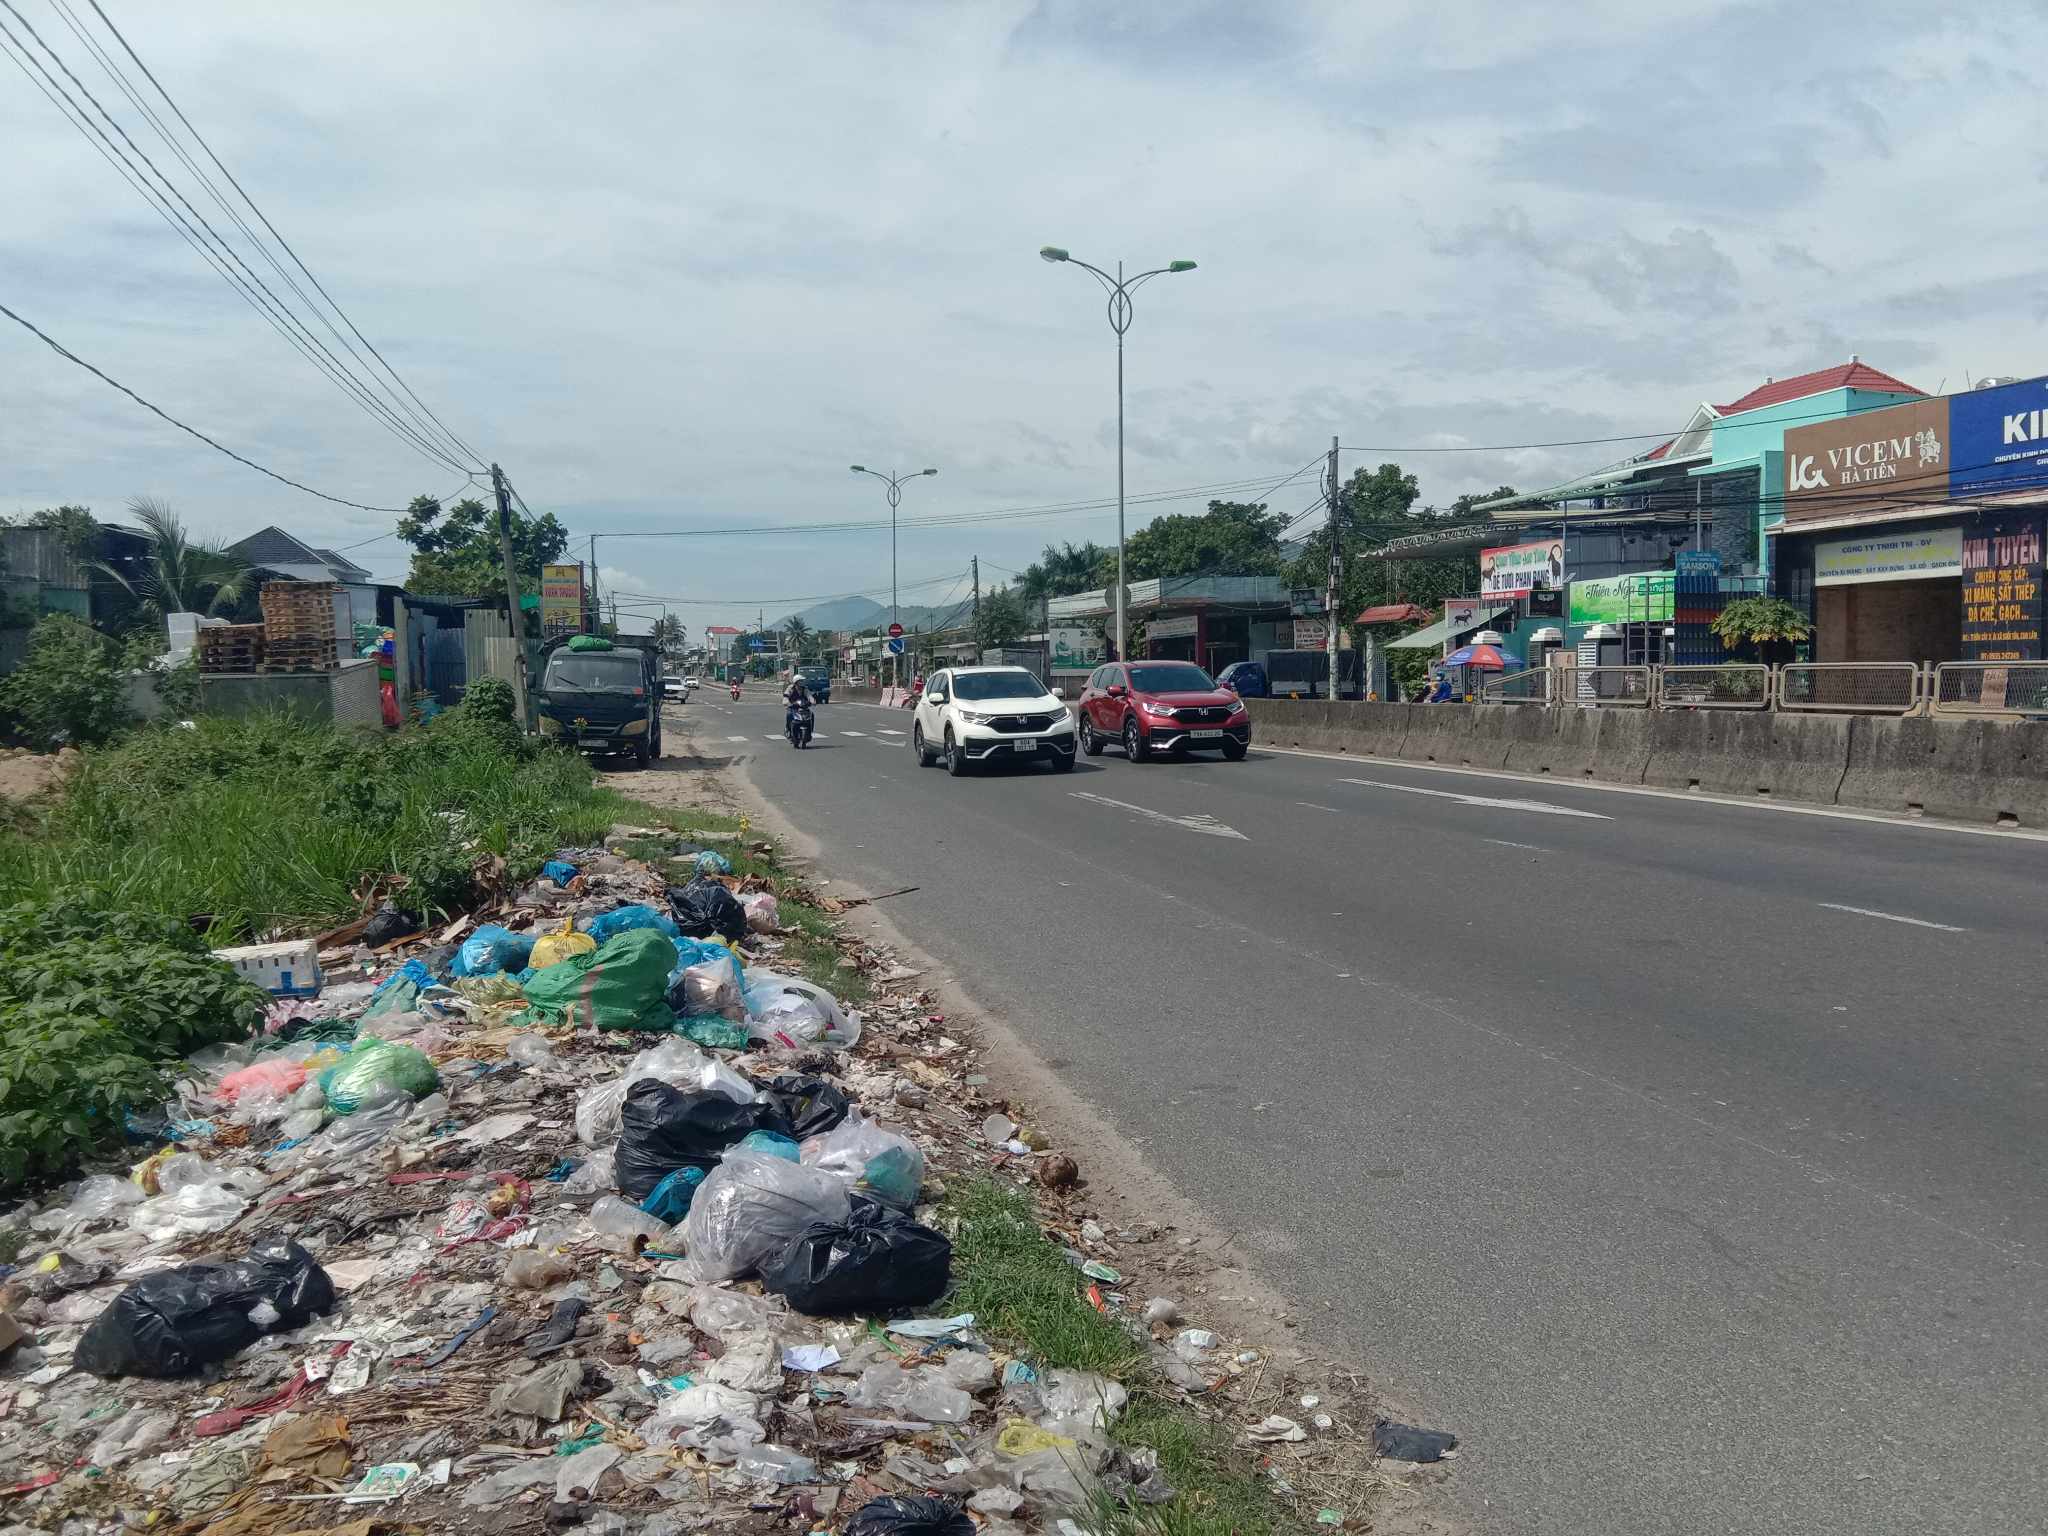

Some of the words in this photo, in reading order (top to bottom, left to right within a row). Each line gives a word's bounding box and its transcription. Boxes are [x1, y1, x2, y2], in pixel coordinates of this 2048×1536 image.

[1827, 436, 1913, 470] VICEM
[1994, 452, 2021, 463] CHUYÊN
[1842, 467, 1861, 484] HÀ
[1864, 463, 1897, 481] TIÊN
[1963, 538, 1988, 568] KIM
[1586, 583, 1611, 600] Thiên
[1964, 587, 1972, 603] XI
[2015, 581, 2035, 600] THÉP
